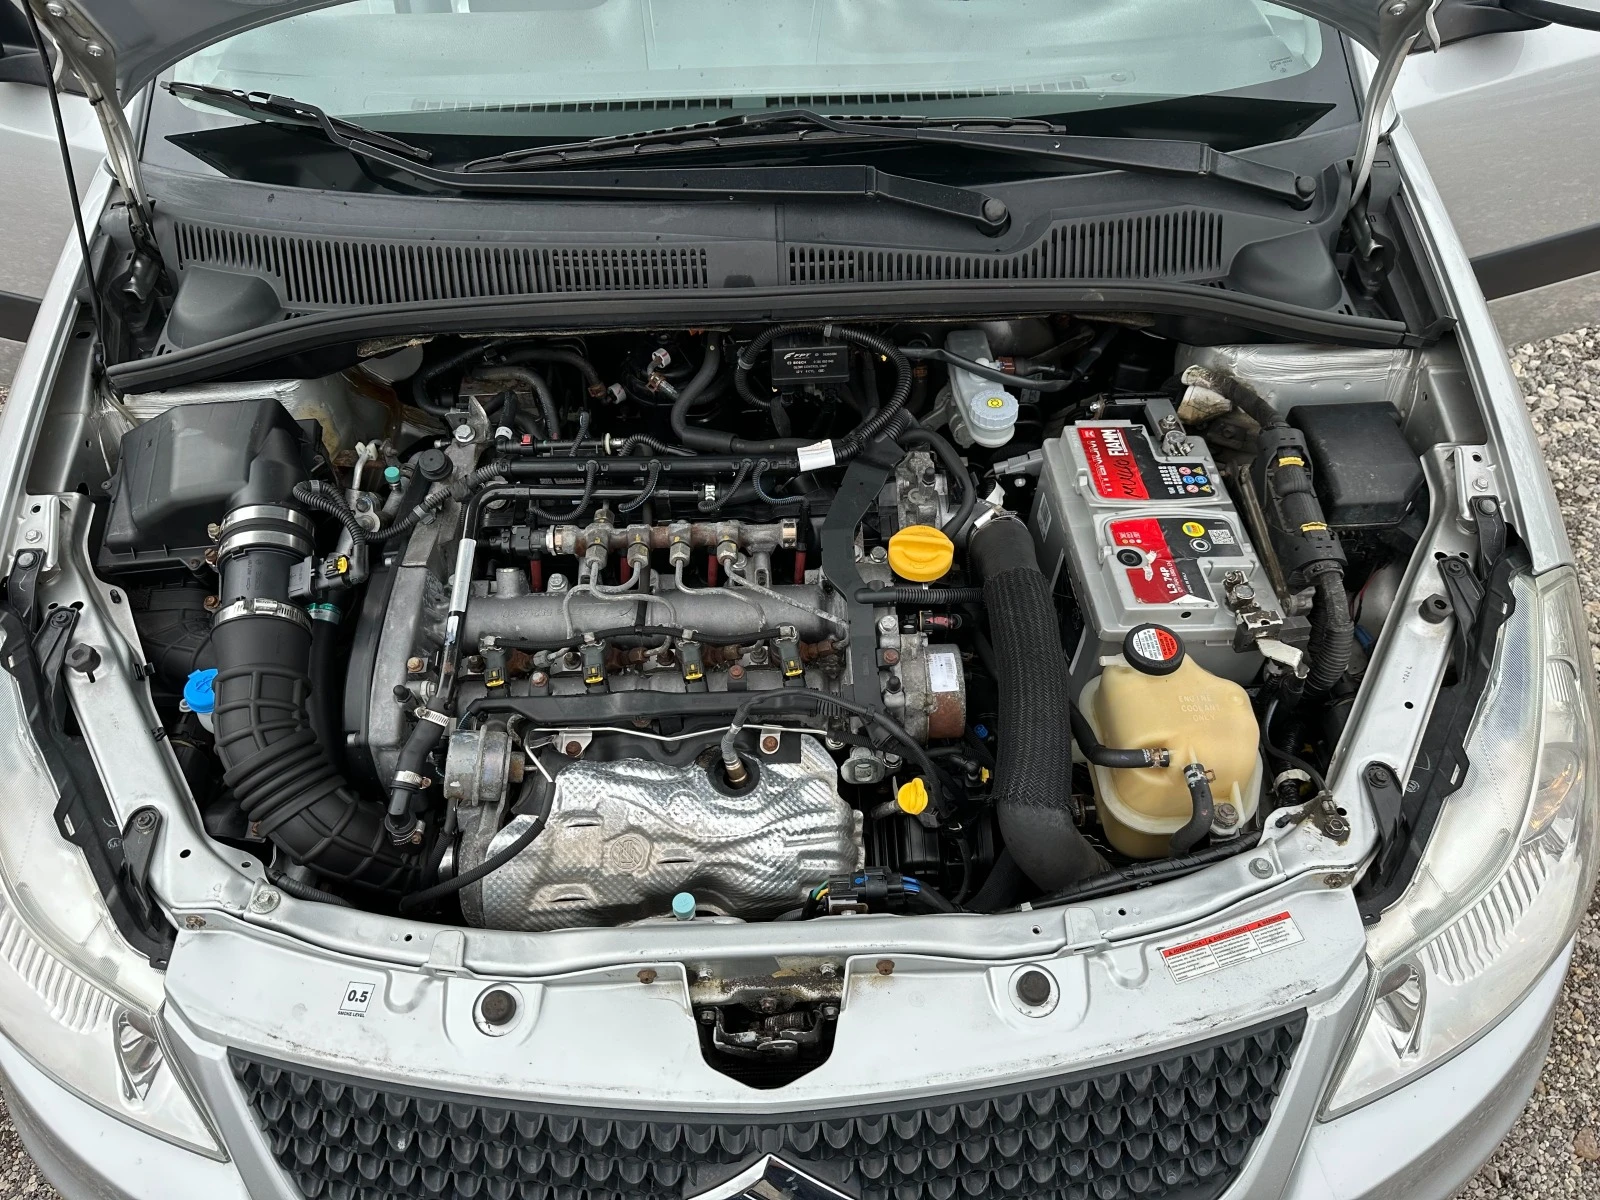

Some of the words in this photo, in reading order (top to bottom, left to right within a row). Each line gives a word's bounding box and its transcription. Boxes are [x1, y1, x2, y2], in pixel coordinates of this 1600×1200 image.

[1100, 429, 1126, 456] FIAMM
[1160, 566, 1173, 582] 74P
[1166, 583, 1178, 594] L3
[1178, 695, 1211, 703] ENGINE
[1181, 704, 1221, 712] COOLANT
[1192, 714, 1216, 722] ONLY
[348, 990, 369, 1003] 0.5
